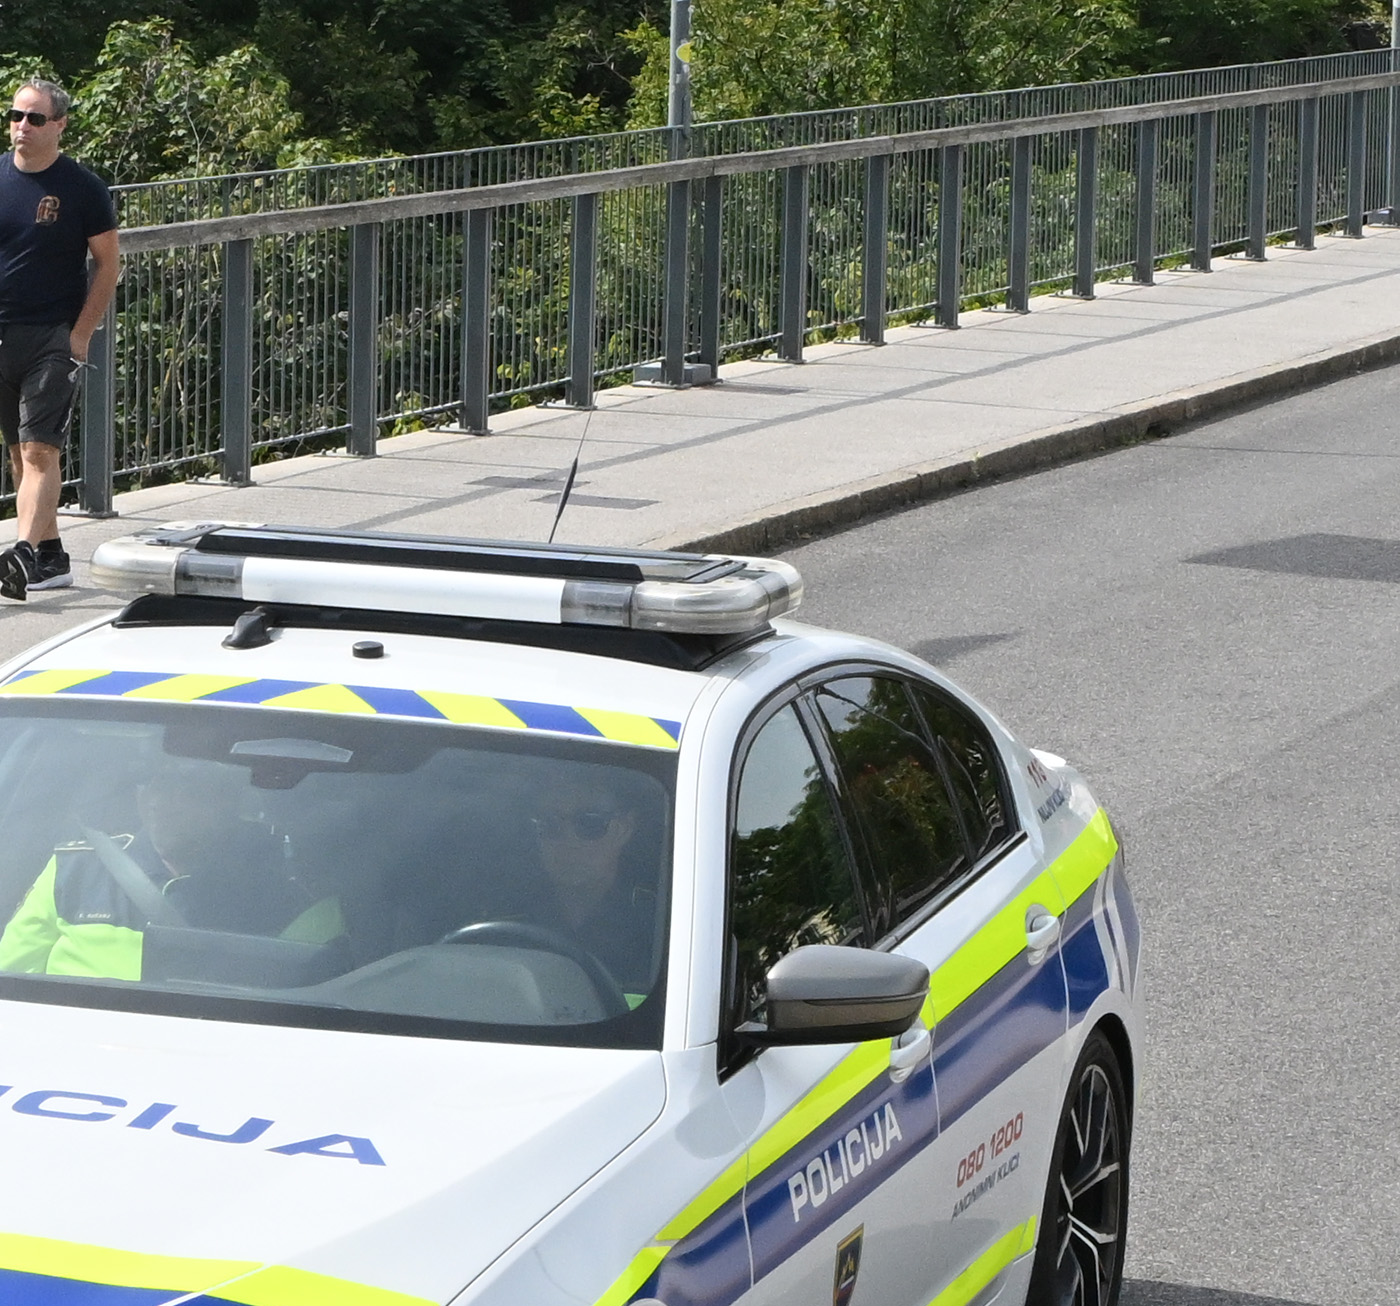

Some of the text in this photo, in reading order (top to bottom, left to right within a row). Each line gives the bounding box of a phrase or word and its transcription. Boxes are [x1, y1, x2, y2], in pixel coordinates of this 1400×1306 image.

[787, 1102, 902, 1222] POLICIJA
[957, 1112, 1023, 1188] 080 1200
